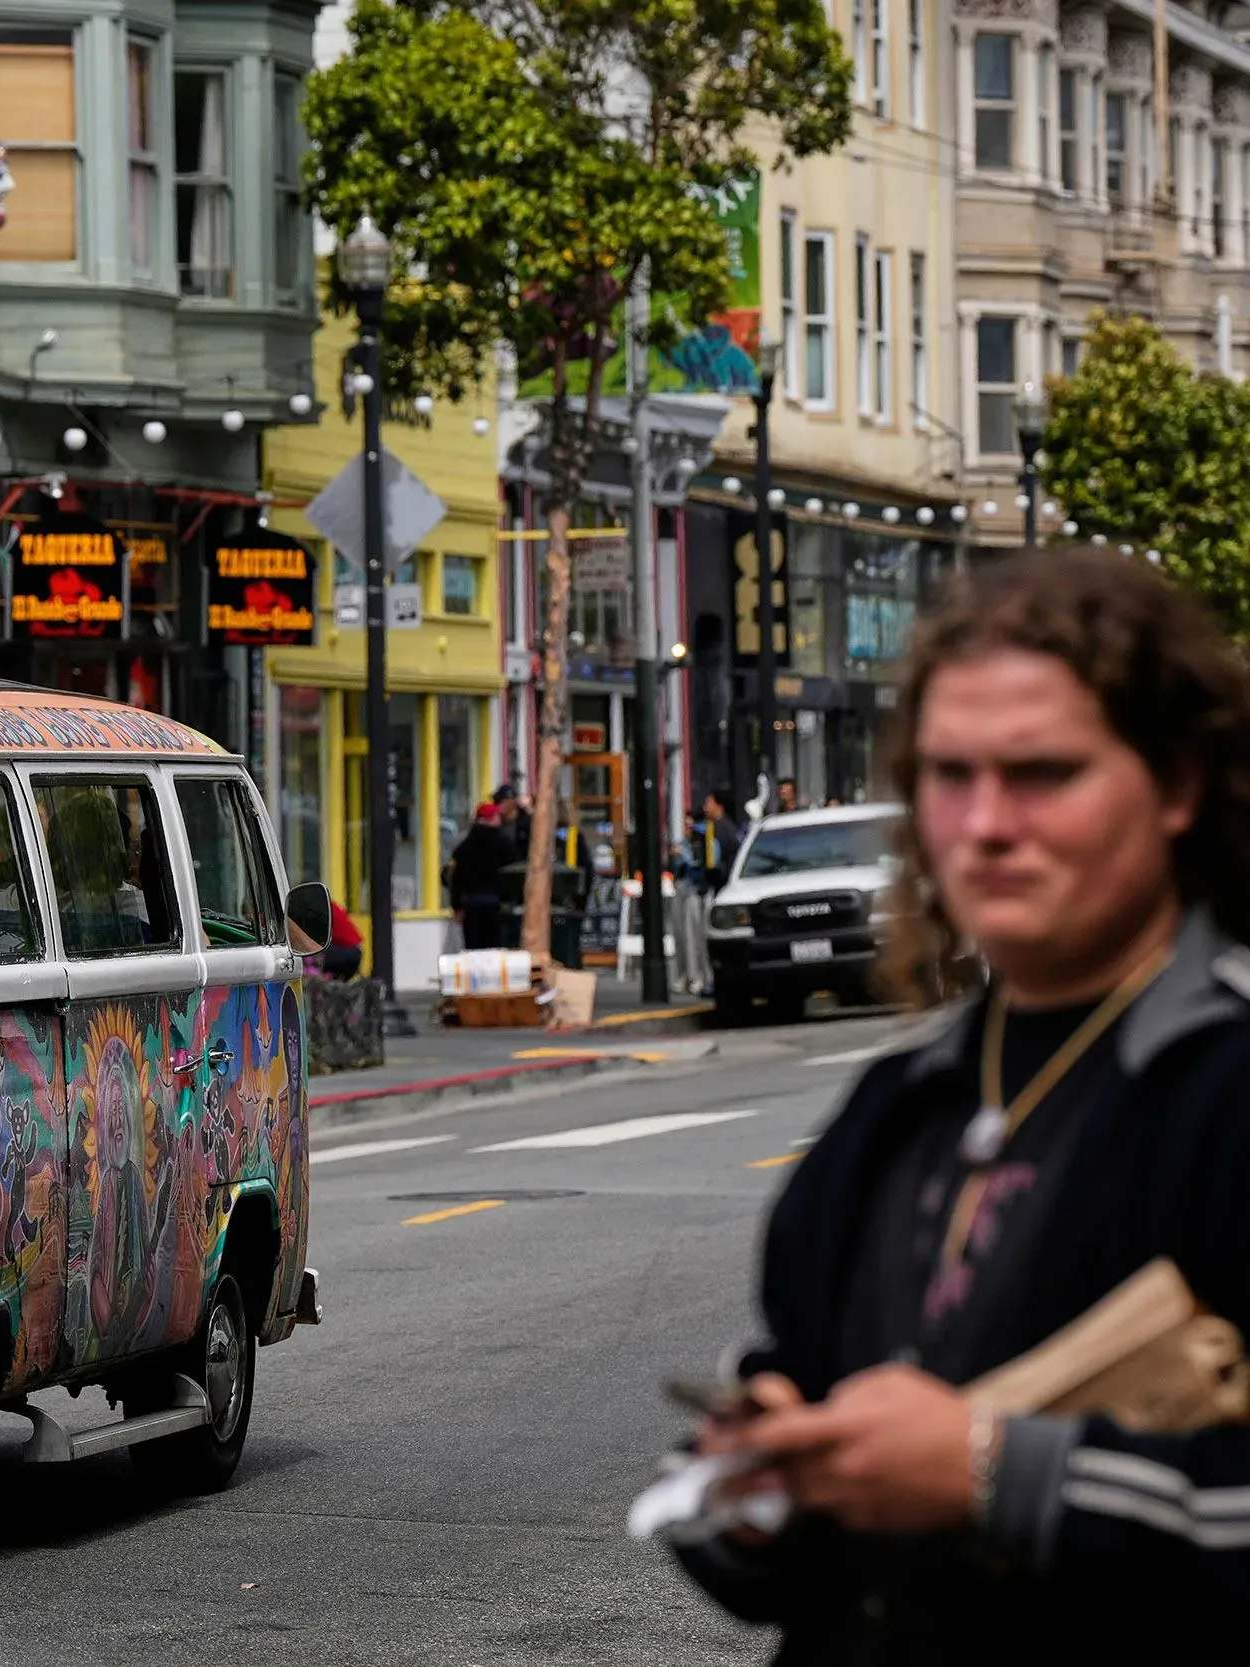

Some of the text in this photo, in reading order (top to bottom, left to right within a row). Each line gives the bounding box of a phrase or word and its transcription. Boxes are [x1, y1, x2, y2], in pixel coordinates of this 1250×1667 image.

[19, 533, 116, 565] TAQUERIA
[216, 549, 307, 579] TAQUERIA
[19, 706, 109, 747] LOVE
[80, 708, 184, 750] TOURS
